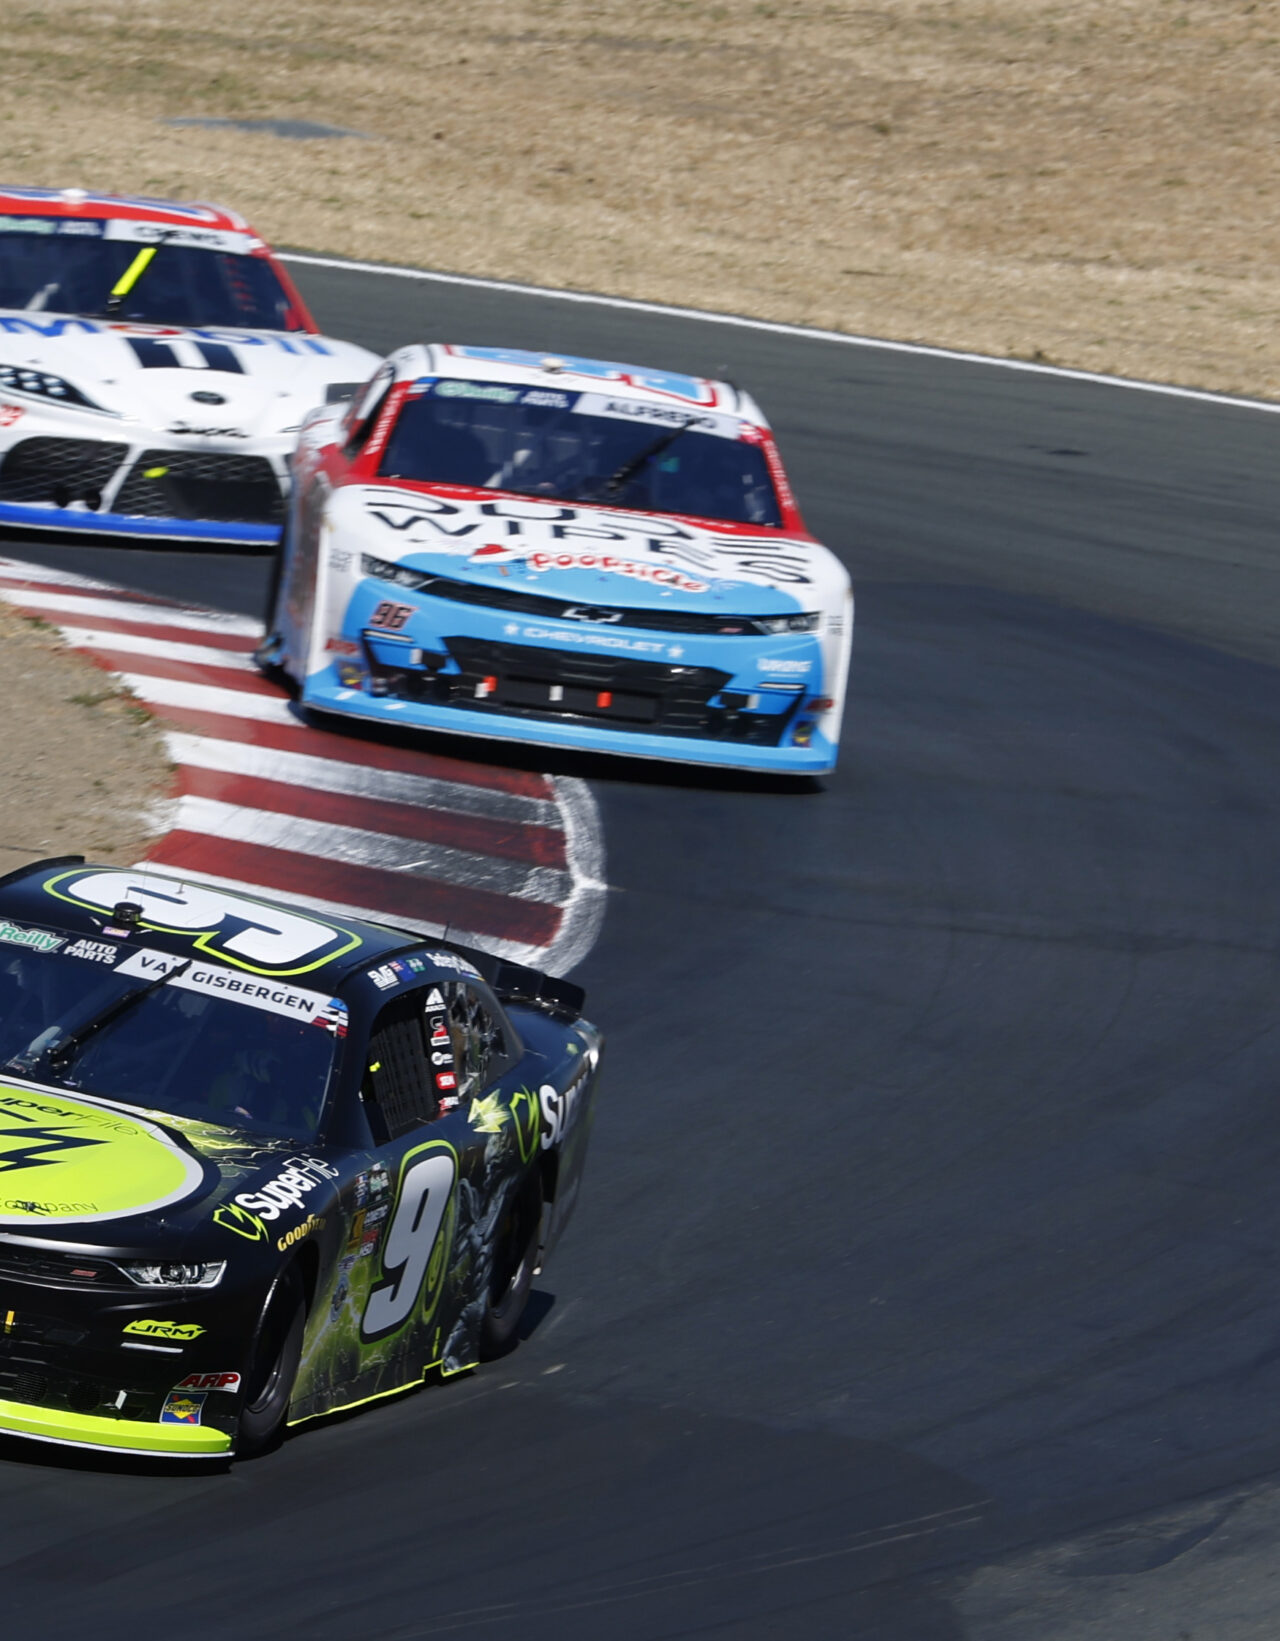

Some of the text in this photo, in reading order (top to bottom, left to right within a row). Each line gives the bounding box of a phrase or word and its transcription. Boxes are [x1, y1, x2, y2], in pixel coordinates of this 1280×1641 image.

[364, 486, 809, 561] DUDE
[367, 510, 813, 584] WIPES
[371, 602, 416, 629] 96
[522, 627, 666, 653] CHEVROLET
[68, 871, 338, 965] 9
[64, 946, 118, 964] PARTS
[74, 939, 118, 955] AUTO
[141, 956, 315, 1013] VA GISBERGEN
[363, 1154, 454, 1335] 9
[131, 1325, 195, 1337] JRM
[178, 1373, 239, 1388] ARP
